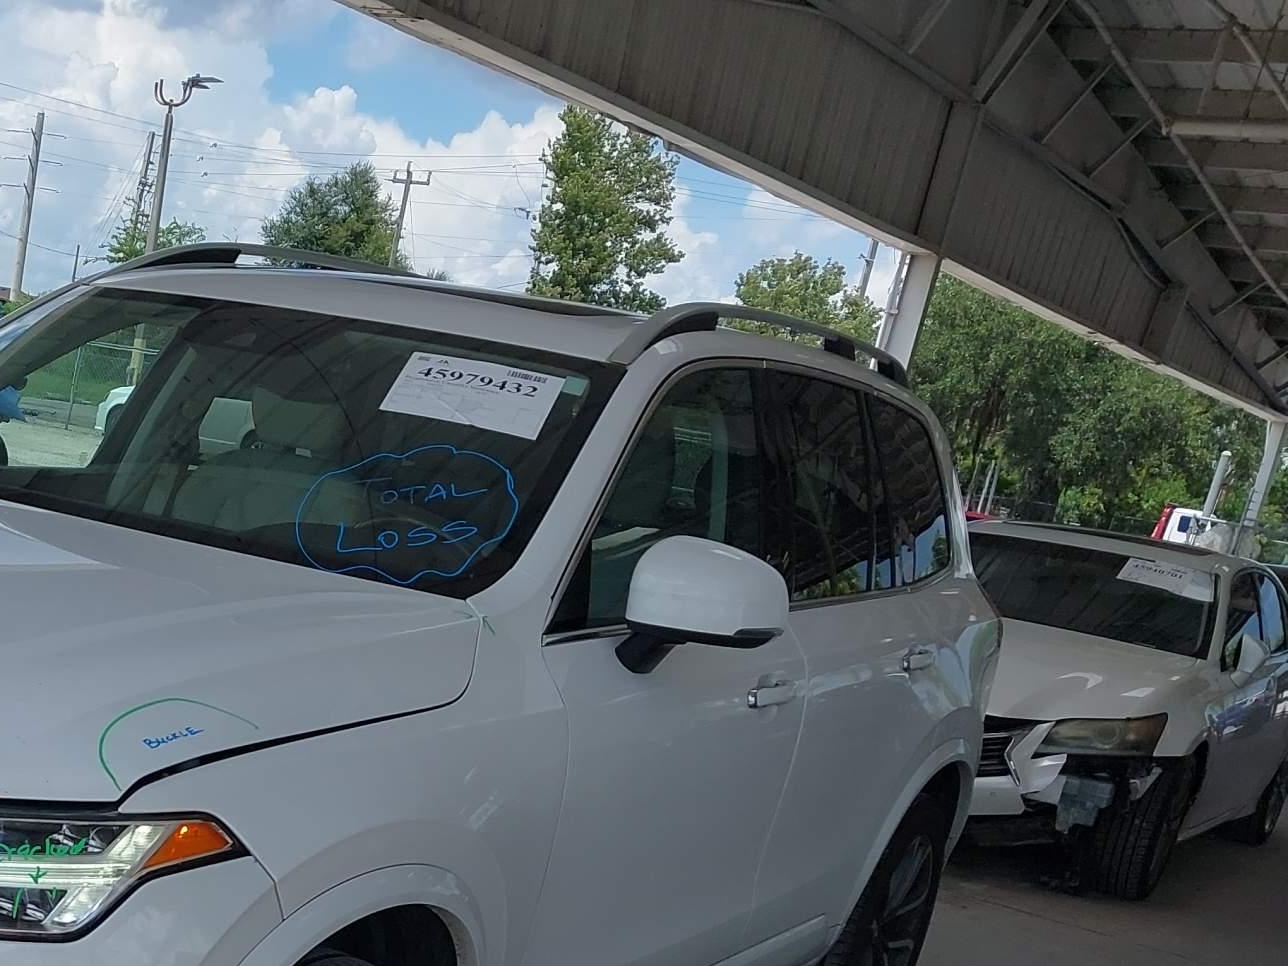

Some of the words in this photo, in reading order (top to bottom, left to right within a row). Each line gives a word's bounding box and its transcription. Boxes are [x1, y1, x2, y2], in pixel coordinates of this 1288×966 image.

[417, 367, 538, 397] 45979432
[353, 477, 488, 504] TOTAL
[337, 520, 478, 553] LOSS
